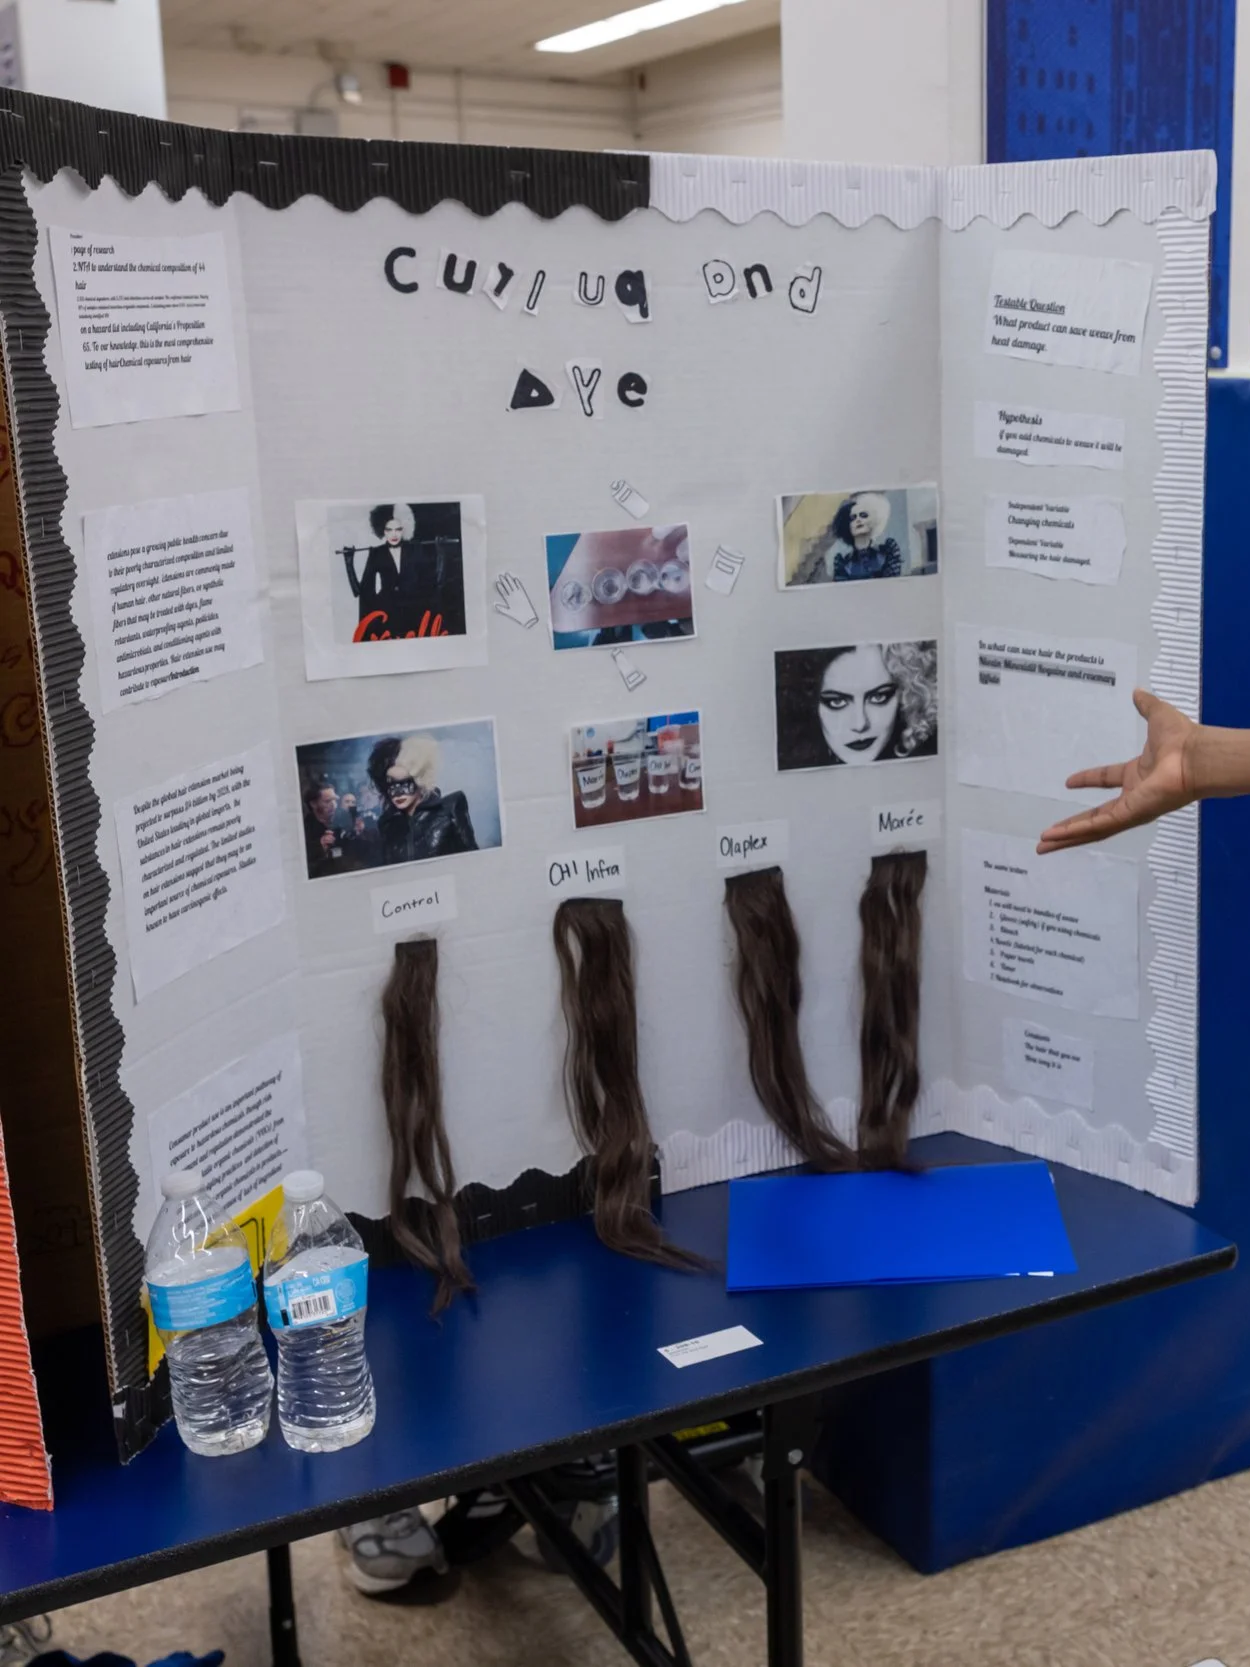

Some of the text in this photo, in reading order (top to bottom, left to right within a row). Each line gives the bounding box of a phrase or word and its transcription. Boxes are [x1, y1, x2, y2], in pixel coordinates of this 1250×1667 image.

[995, 295, 1065, 315] Testable Question
[994, 315, 1136, 344] What product can save weave from
[991, 336, 1010, 347] heat
[999, 411, 1042, 425] Hypothesis
[1008, 515, 1074, 529] Changing chemicals
[720, 835, 767, 858] Olaplex
[586, 859, 620, 882] Infra
[381, 891, 439, 918] Control
